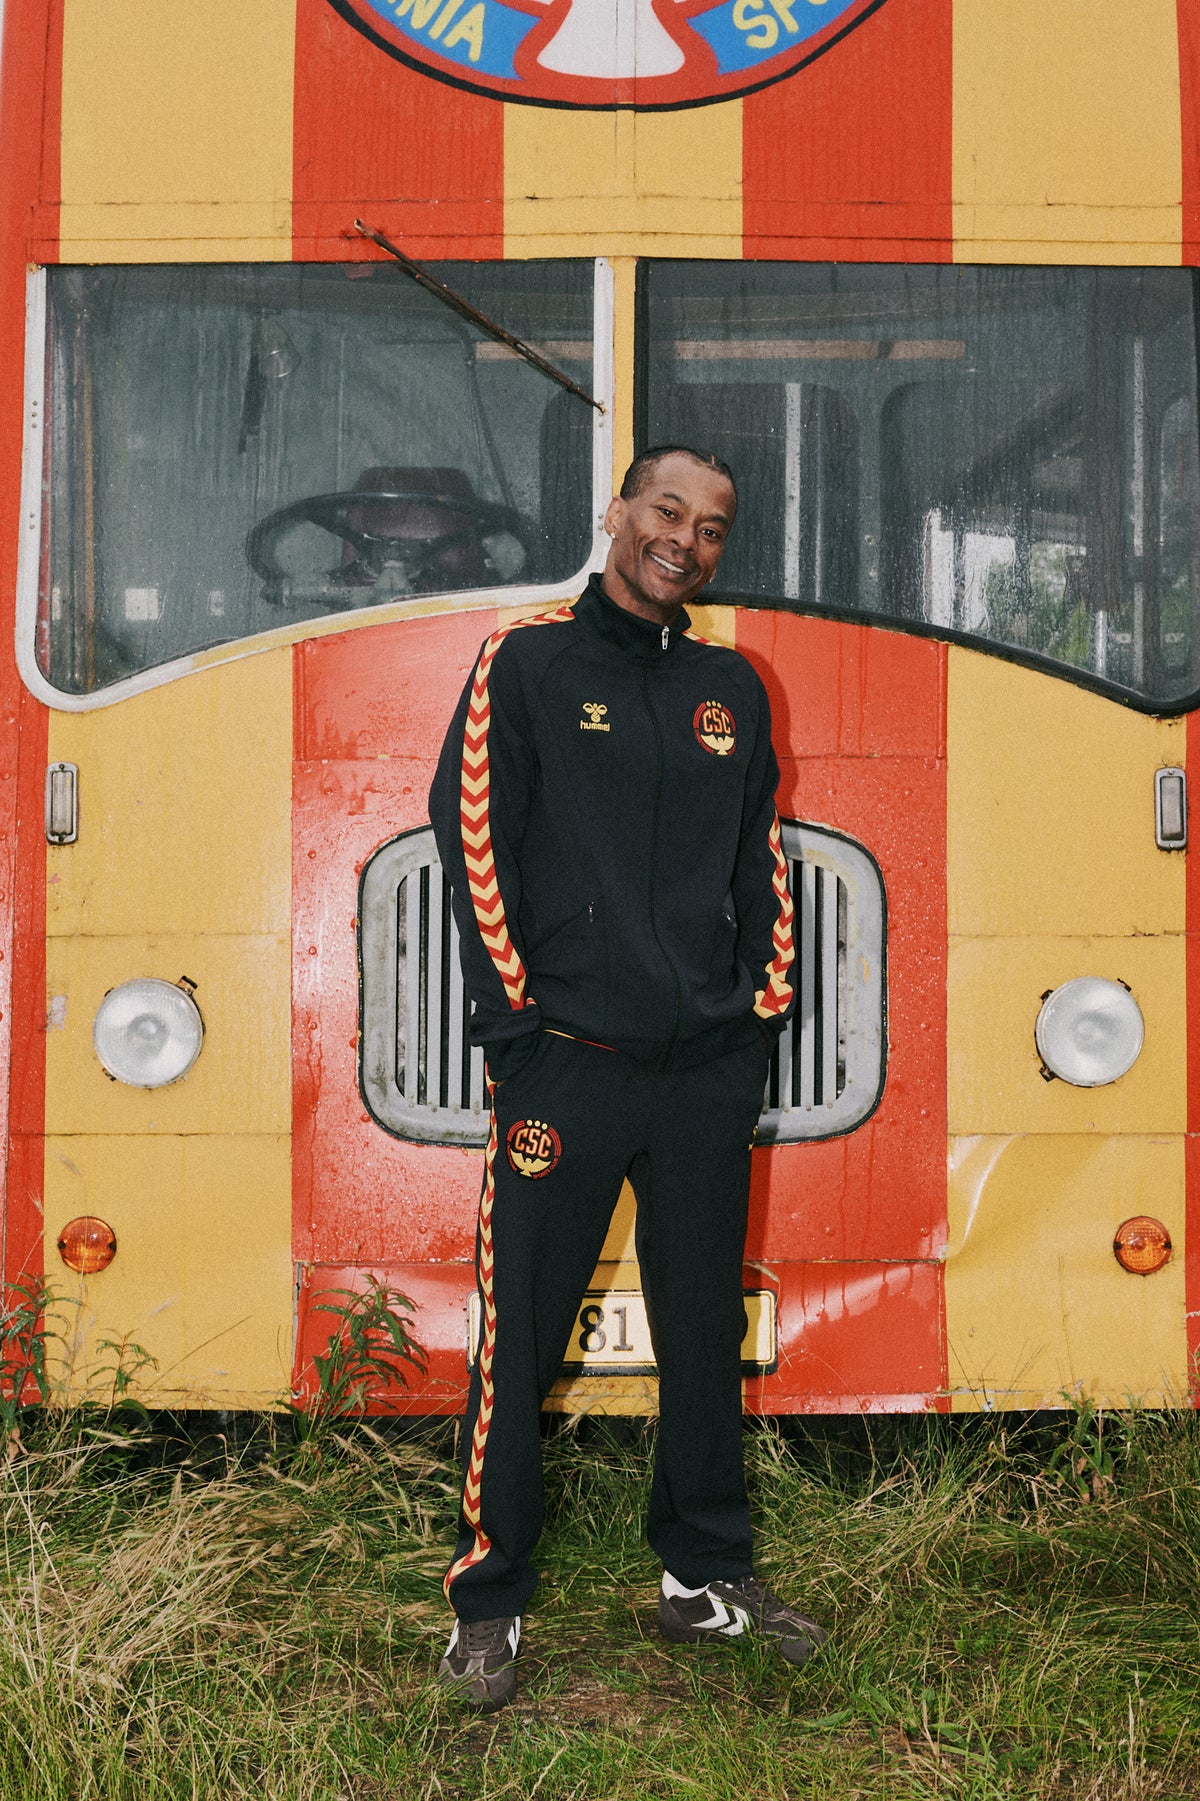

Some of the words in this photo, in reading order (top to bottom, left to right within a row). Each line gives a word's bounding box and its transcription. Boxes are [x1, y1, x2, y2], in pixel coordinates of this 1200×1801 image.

[386, 0, 486, 62] NIA
[732, 0, 828, 49] SP
[580, 719, 611, 732] hummel
[702, 708, 731, 734] CSC
[515, 1128, 552, 1158] CSC
[578, 1304, 634, 1353] 81
